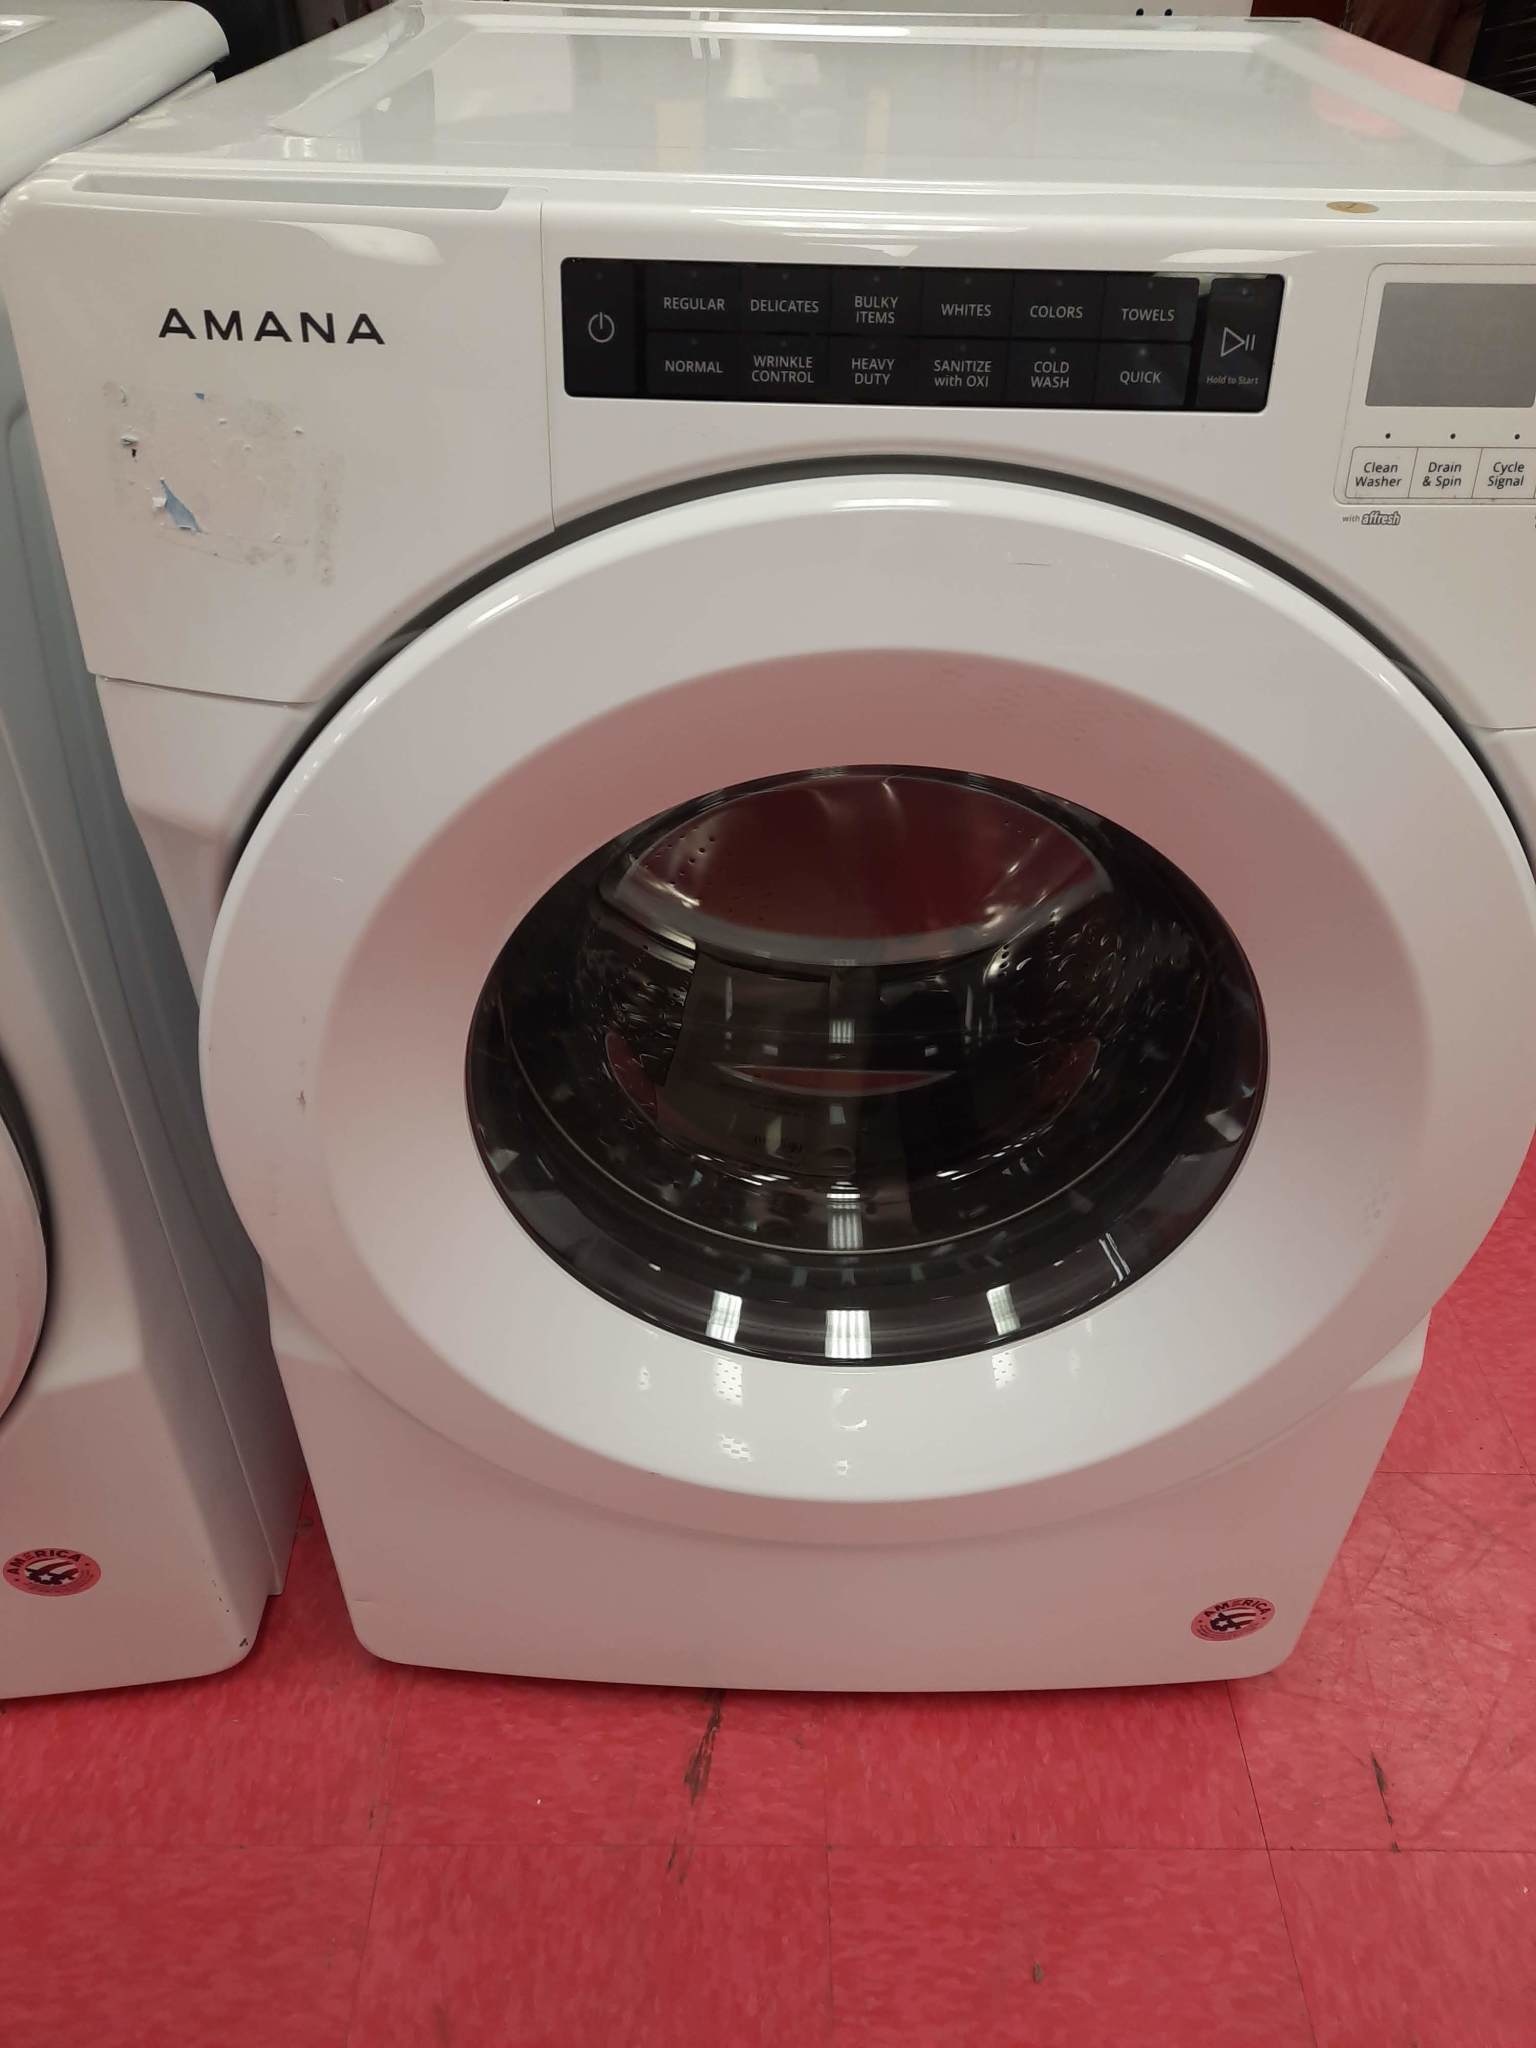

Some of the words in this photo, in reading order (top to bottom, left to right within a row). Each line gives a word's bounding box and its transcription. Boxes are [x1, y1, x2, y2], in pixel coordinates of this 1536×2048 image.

[663, 296, 726, 312] REGULAR
[750, 299, 820, 314] DELICATES
[854, 295, 899, 310] BULKY
[855, 310, 896, 324] ITEMS
[941, 303, 992, 318] WHITES
[1029, 305, 1084, 320] COLORS
[1121, 308, 1176, 323] TOWELS
[158, 308, 386, 345] AMANA
[664, 359, 723, 374] NORMAL
[753, 355, 813, 369] WRINKLE
[851, 357, 896, 372] HEAVY
[933, 359, 992, 374] SANITIZE
[1033, 360, 1070, 374] COLD
[751, 369, 815, 384] CONTROL
[854, 372, 891, 386] DUTY
[934, 374, 963, 388] with
[965, 374, 990, 389] OXI
[1030, 375, 1070, 389] WASH
[1119, 370, 1162, 386] QUICK
[1206, 374, 1226, 385] Hold
[1228, 375, 1236, 385] to
[1238, 375, 1259, 386] Start
[1363, 461, 1398, 473] Clean
[1427, 461, 1462, 474] Drain
[1493, 461, 1525, 475] Cycle
[1355, 475, 1402, 487] Washer
[1422, 475, 1432, 487] &
[1436, 475, 1462, 490] Spin
[1487, 475, 1524, 489] Signal
[1342, 514, 1360, 523] with
[1361, 511, 1401, 526] affresh
[7, 1549, 82, 1575] AMERICA
[1203, 1598, 1272, 1618] AMERICA
